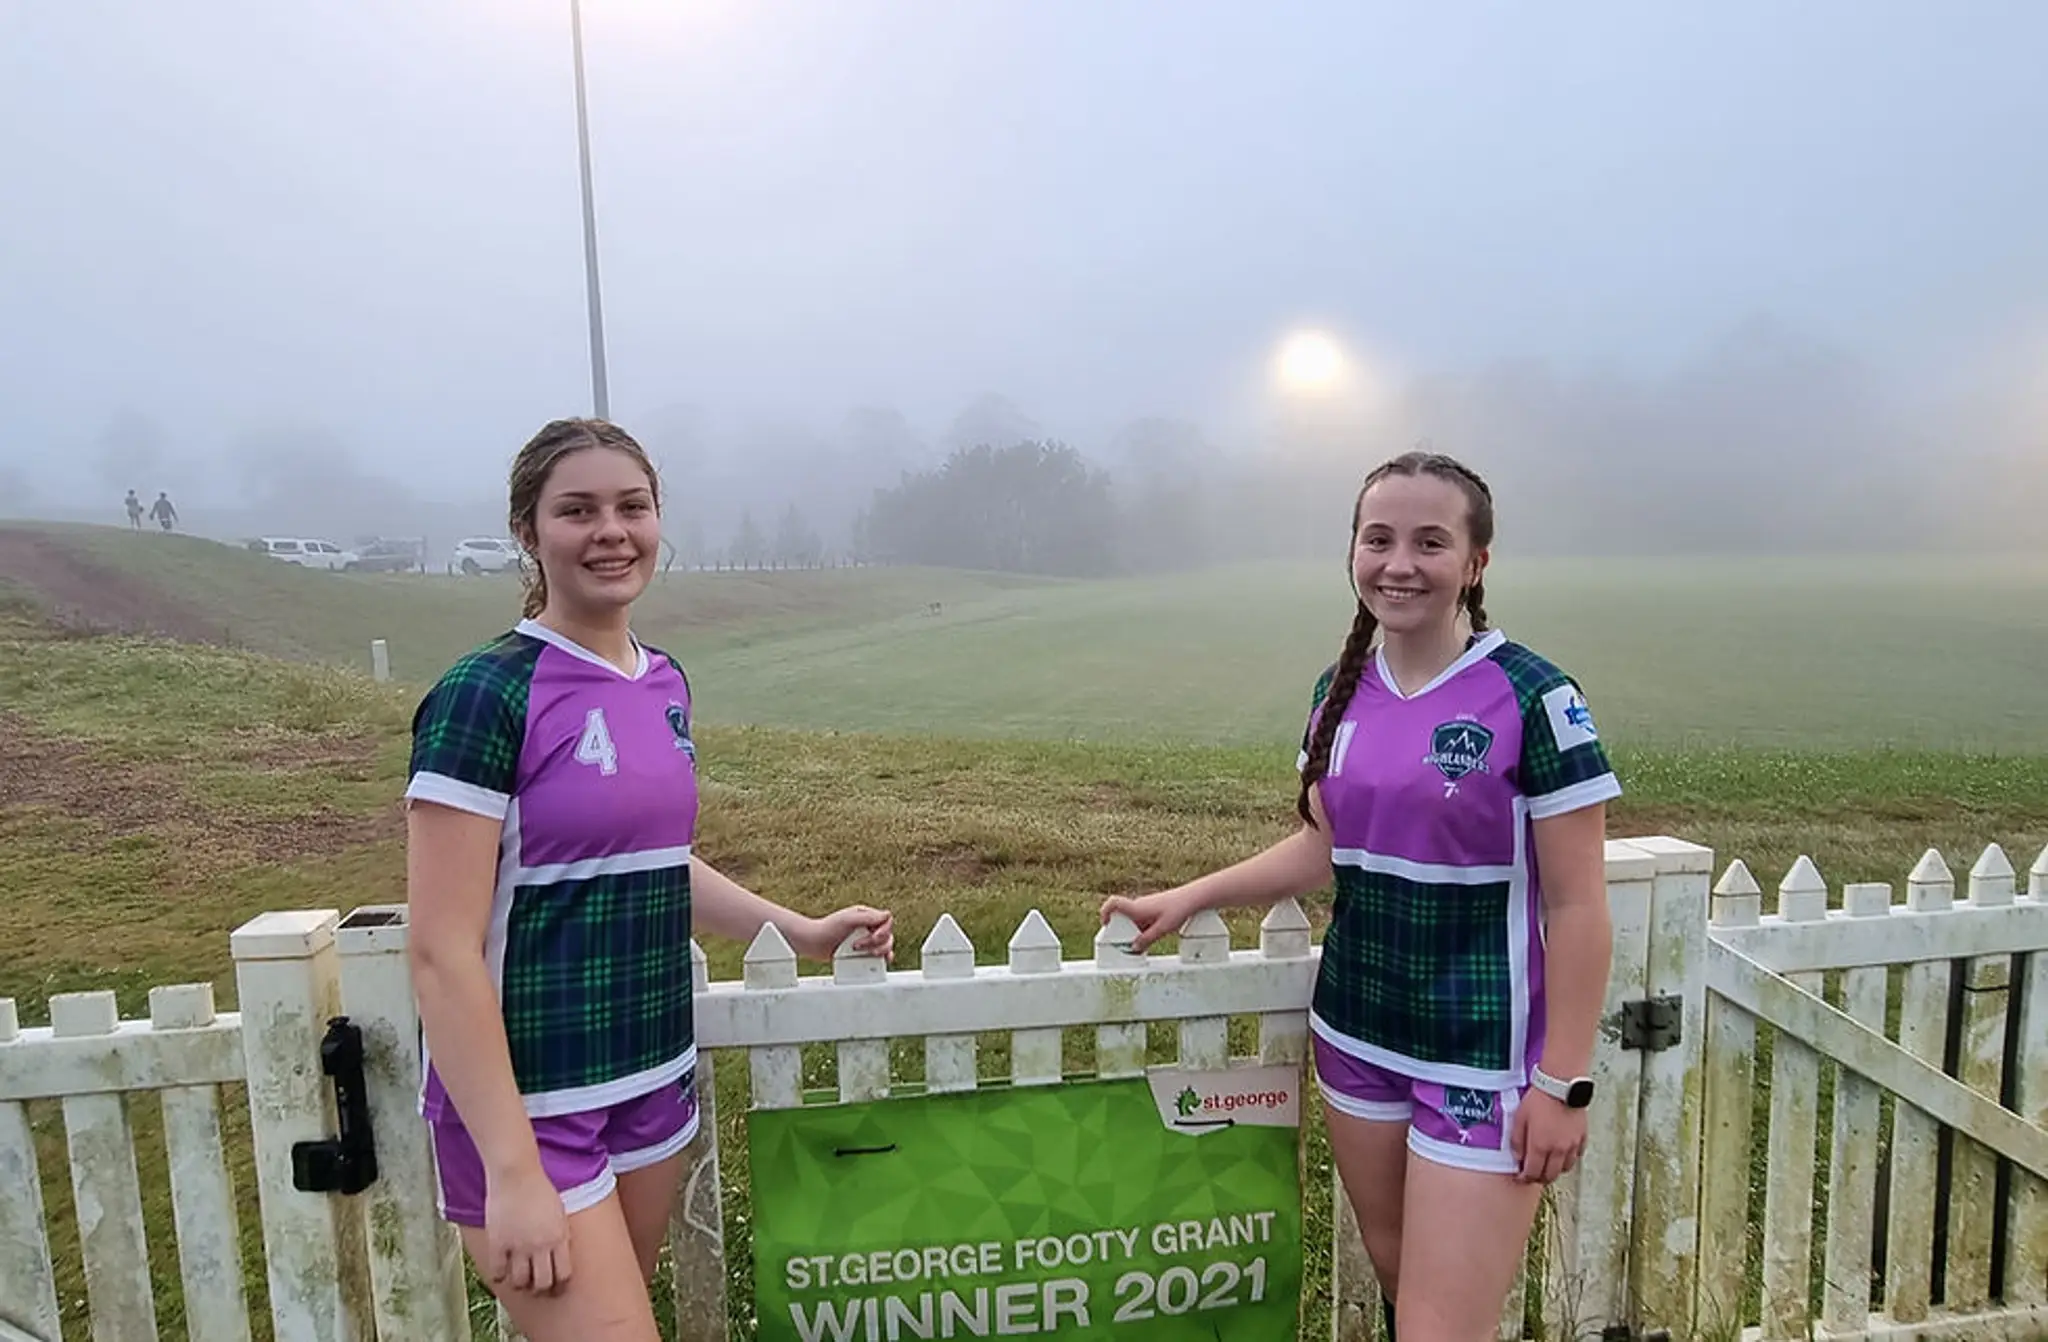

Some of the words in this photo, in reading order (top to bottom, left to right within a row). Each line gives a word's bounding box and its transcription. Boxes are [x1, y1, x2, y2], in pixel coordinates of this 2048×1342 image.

[574, 708, 618, 776] 4
[1203, 1090, 1289, 1111] st.george
[786, 1242, 1003, 1289] ST.GEORGE
[1015, 1227, 1141, 1270] FOOTY
[1151, 1211, 1276, 1256] GRANT
[788, 1277, 1091, 1342] WINNER
[1113, 1256, 1267, 1323] 2021
